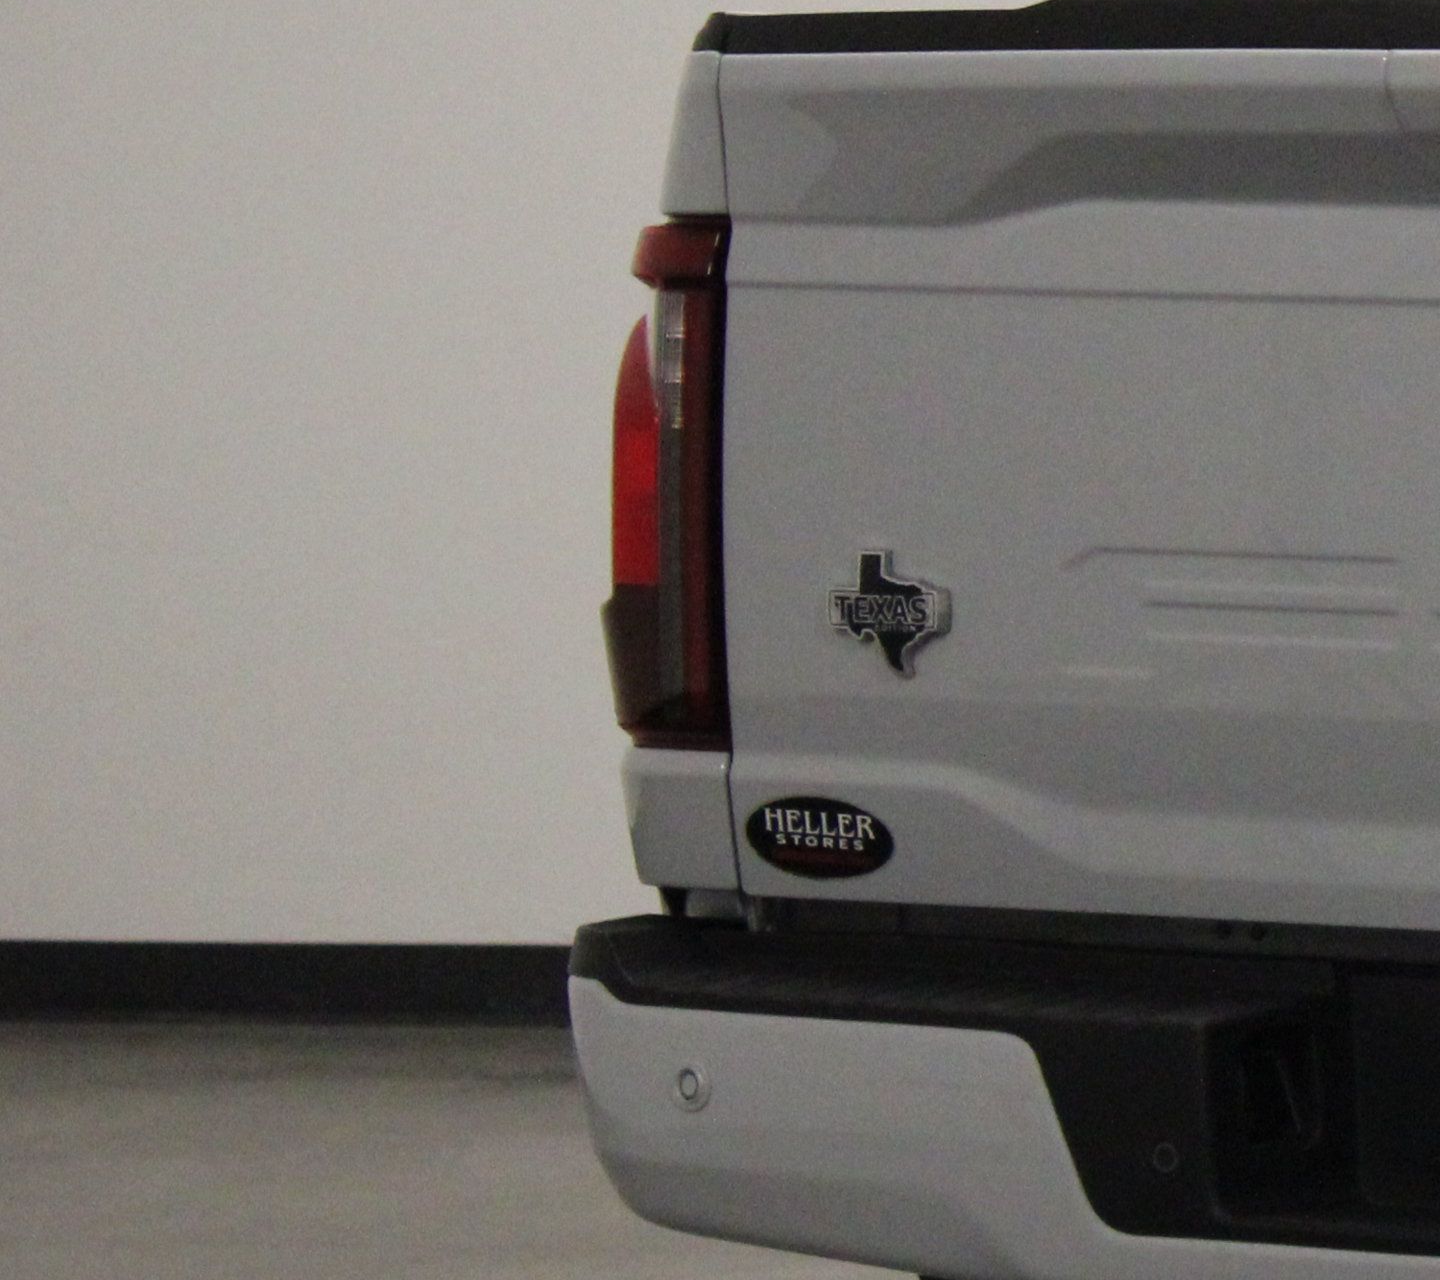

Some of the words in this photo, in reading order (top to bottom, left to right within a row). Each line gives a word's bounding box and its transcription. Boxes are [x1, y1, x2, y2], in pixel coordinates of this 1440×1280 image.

[833, 594, 929, 625] TEXAS
[764, 807, 876, 841] HELLER
[775, 832, 865, 852] STORES
